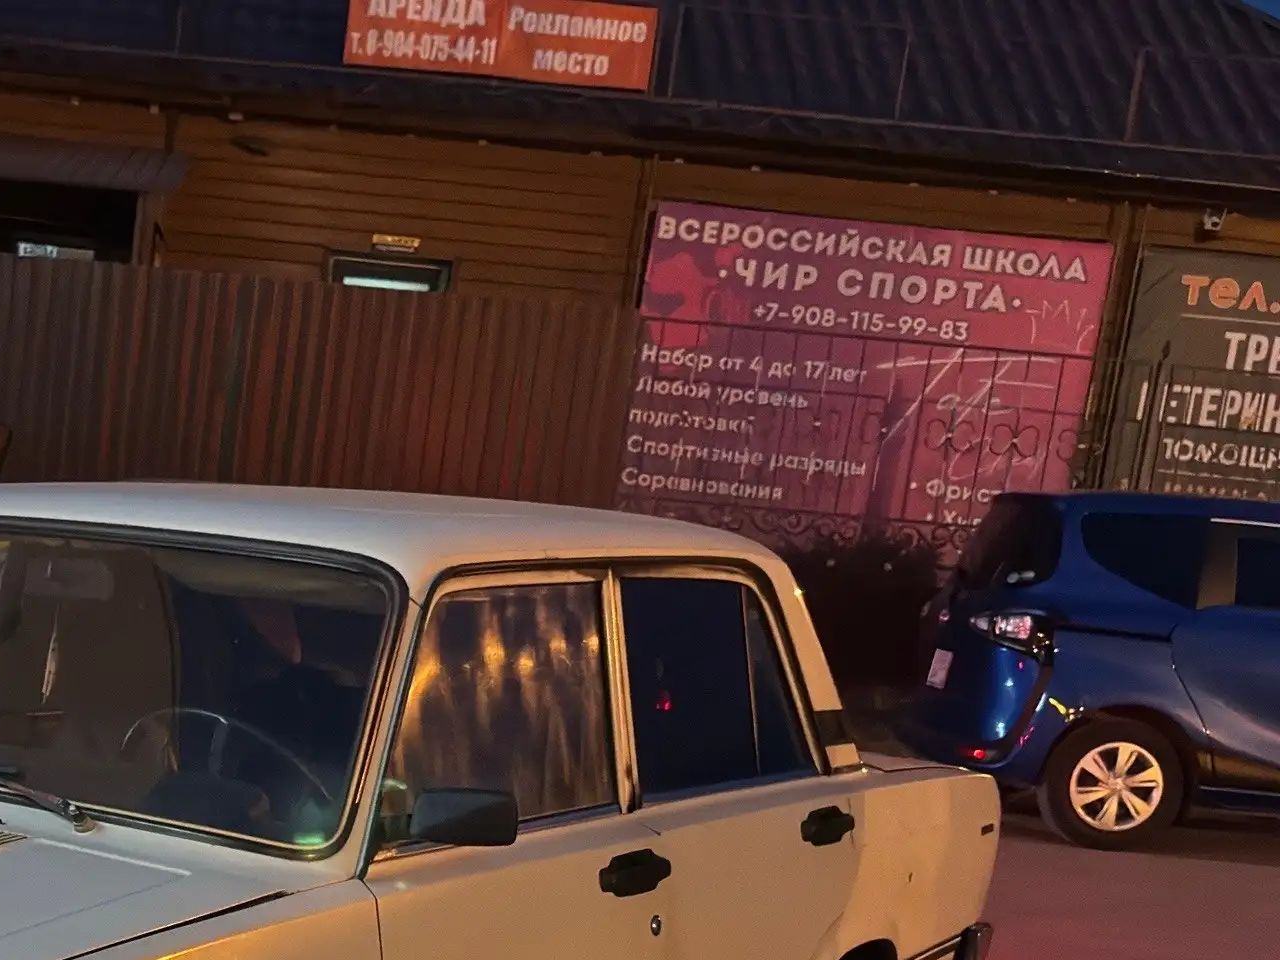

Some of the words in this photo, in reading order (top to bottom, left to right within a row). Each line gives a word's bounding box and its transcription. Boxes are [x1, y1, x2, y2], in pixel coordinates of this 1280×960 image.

[367, 0, 486, 29] АРЕНДА
[656, 215, 952, 268] ВСЕРОССИЙСКАЯ
[962, 245, 1087, 282] ШКОЛА
[752, 302, 969, 341] +7-908-115-99-83
[641, 343, 713, 372] Набор
[720, 356, 745, 371] от
[749, 355, 765, 372] 4
[804, 360, 827, 379] 17
[828, 364, 869, 384] лет
[636, 375, 711, 400] Любой
